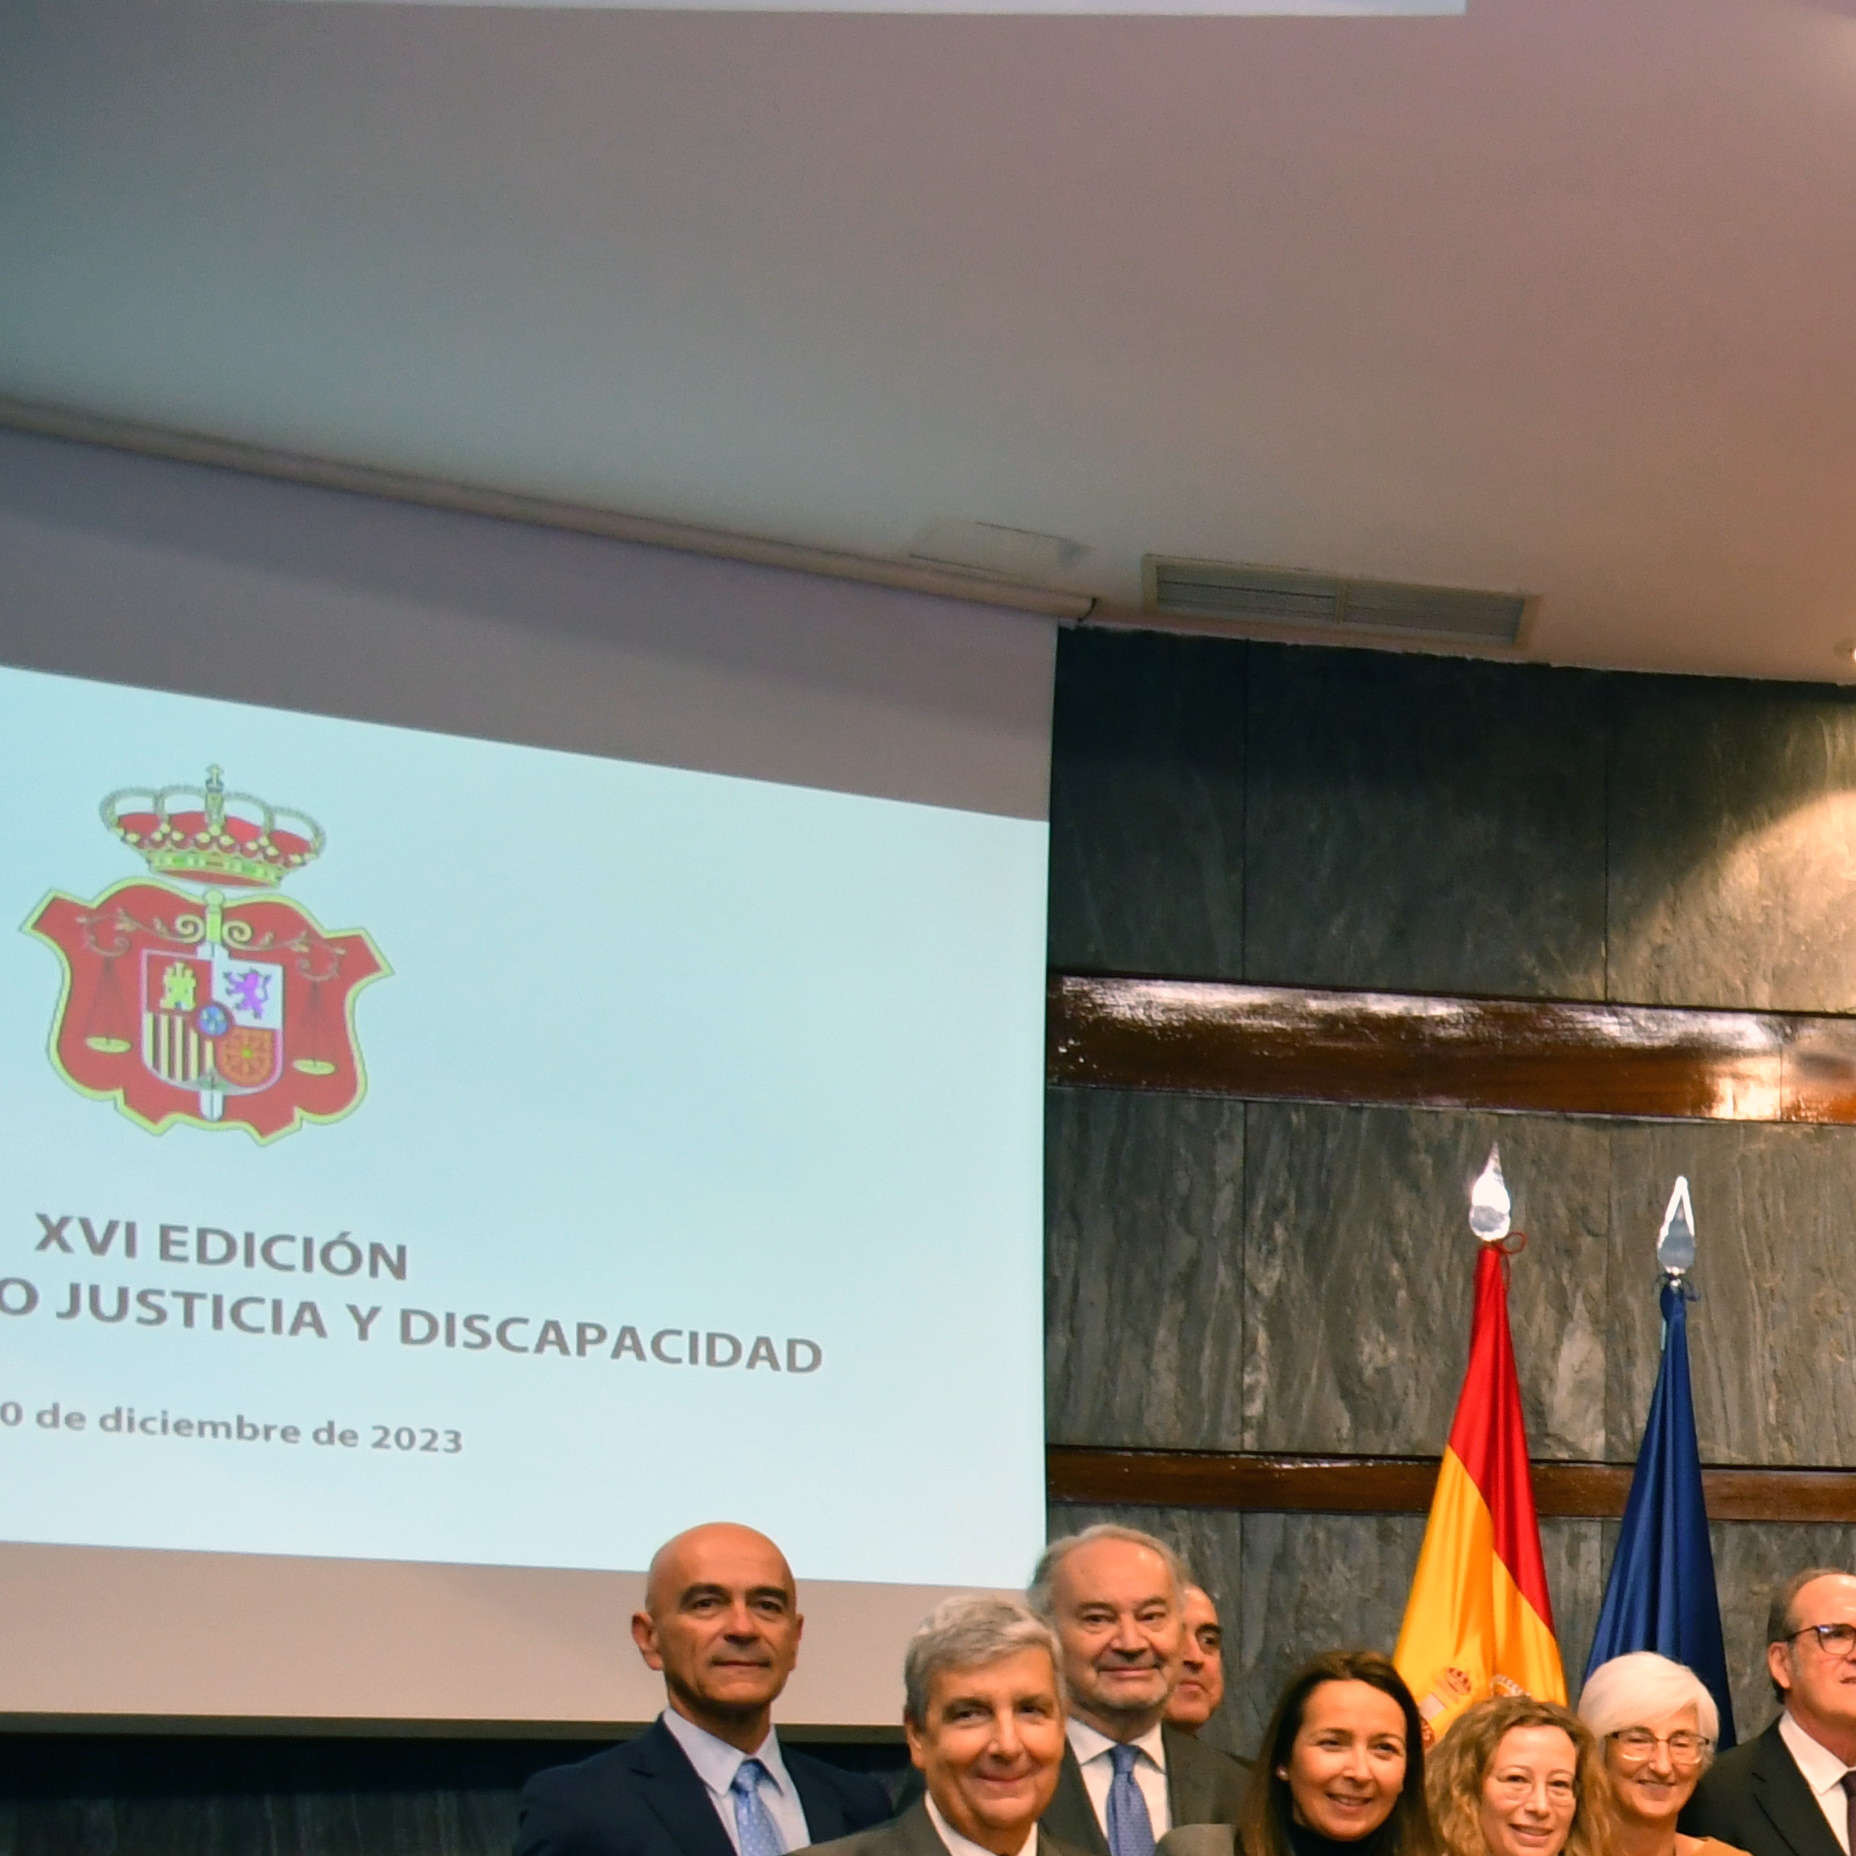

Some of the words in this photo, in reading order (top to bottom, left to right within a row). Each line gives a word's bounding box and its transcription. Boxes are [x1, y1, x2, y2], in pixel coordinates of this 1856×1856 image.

[36, 1213, 136, 1258] XVI
[159, 1224, 407, 1281] EDICIÓN
[56, 1282, 327, 1338] JUSTICIA
[347, 1304, 381, 1341] Y
[400, 1308, 822, 1373] DISCAPACIDAD
[35, 1402, 86, 1430] de
[99, 1406, 301, 1443] diciembre
[312, 1420, 358, 1446] de
[372, 1425, 462, 1453] 2023
